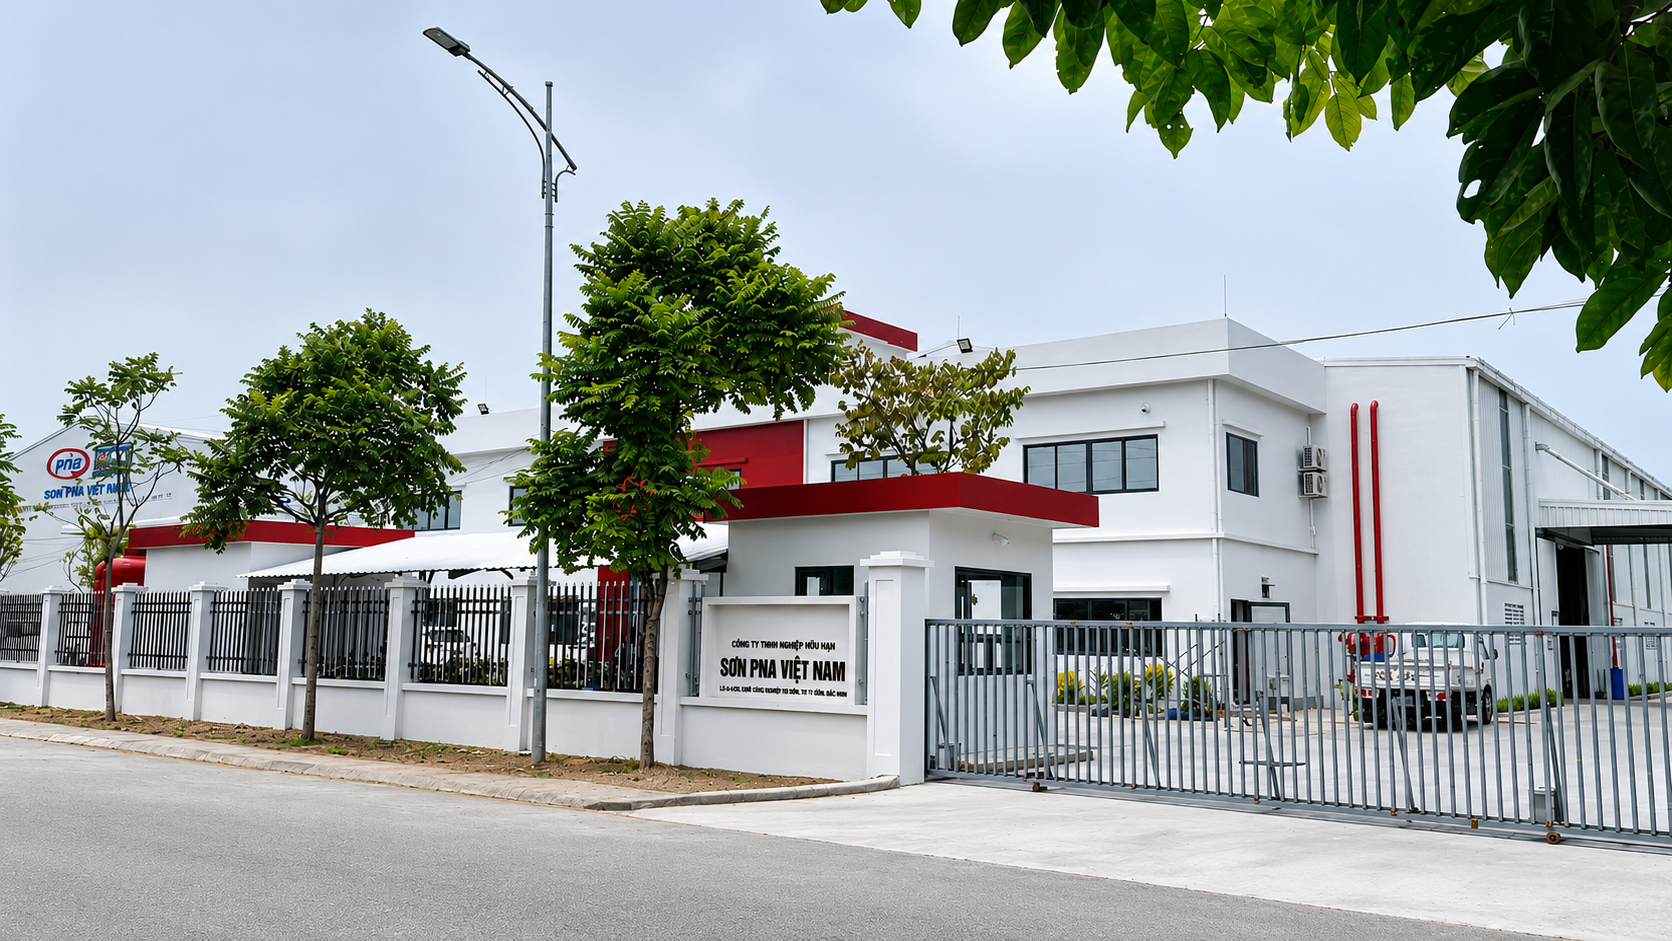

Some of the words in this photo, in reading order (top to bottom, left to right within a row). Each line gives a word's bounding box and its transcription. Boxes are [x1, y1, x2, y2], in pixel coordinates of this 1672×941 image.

[750, 640, 760, 648] TY
[719, 656, 747, 678] SƠN
[749, 658, 777, 679] PNA
[780, 655, 810, 684] VIỆT
[812, 660, 846, 682] NAM
